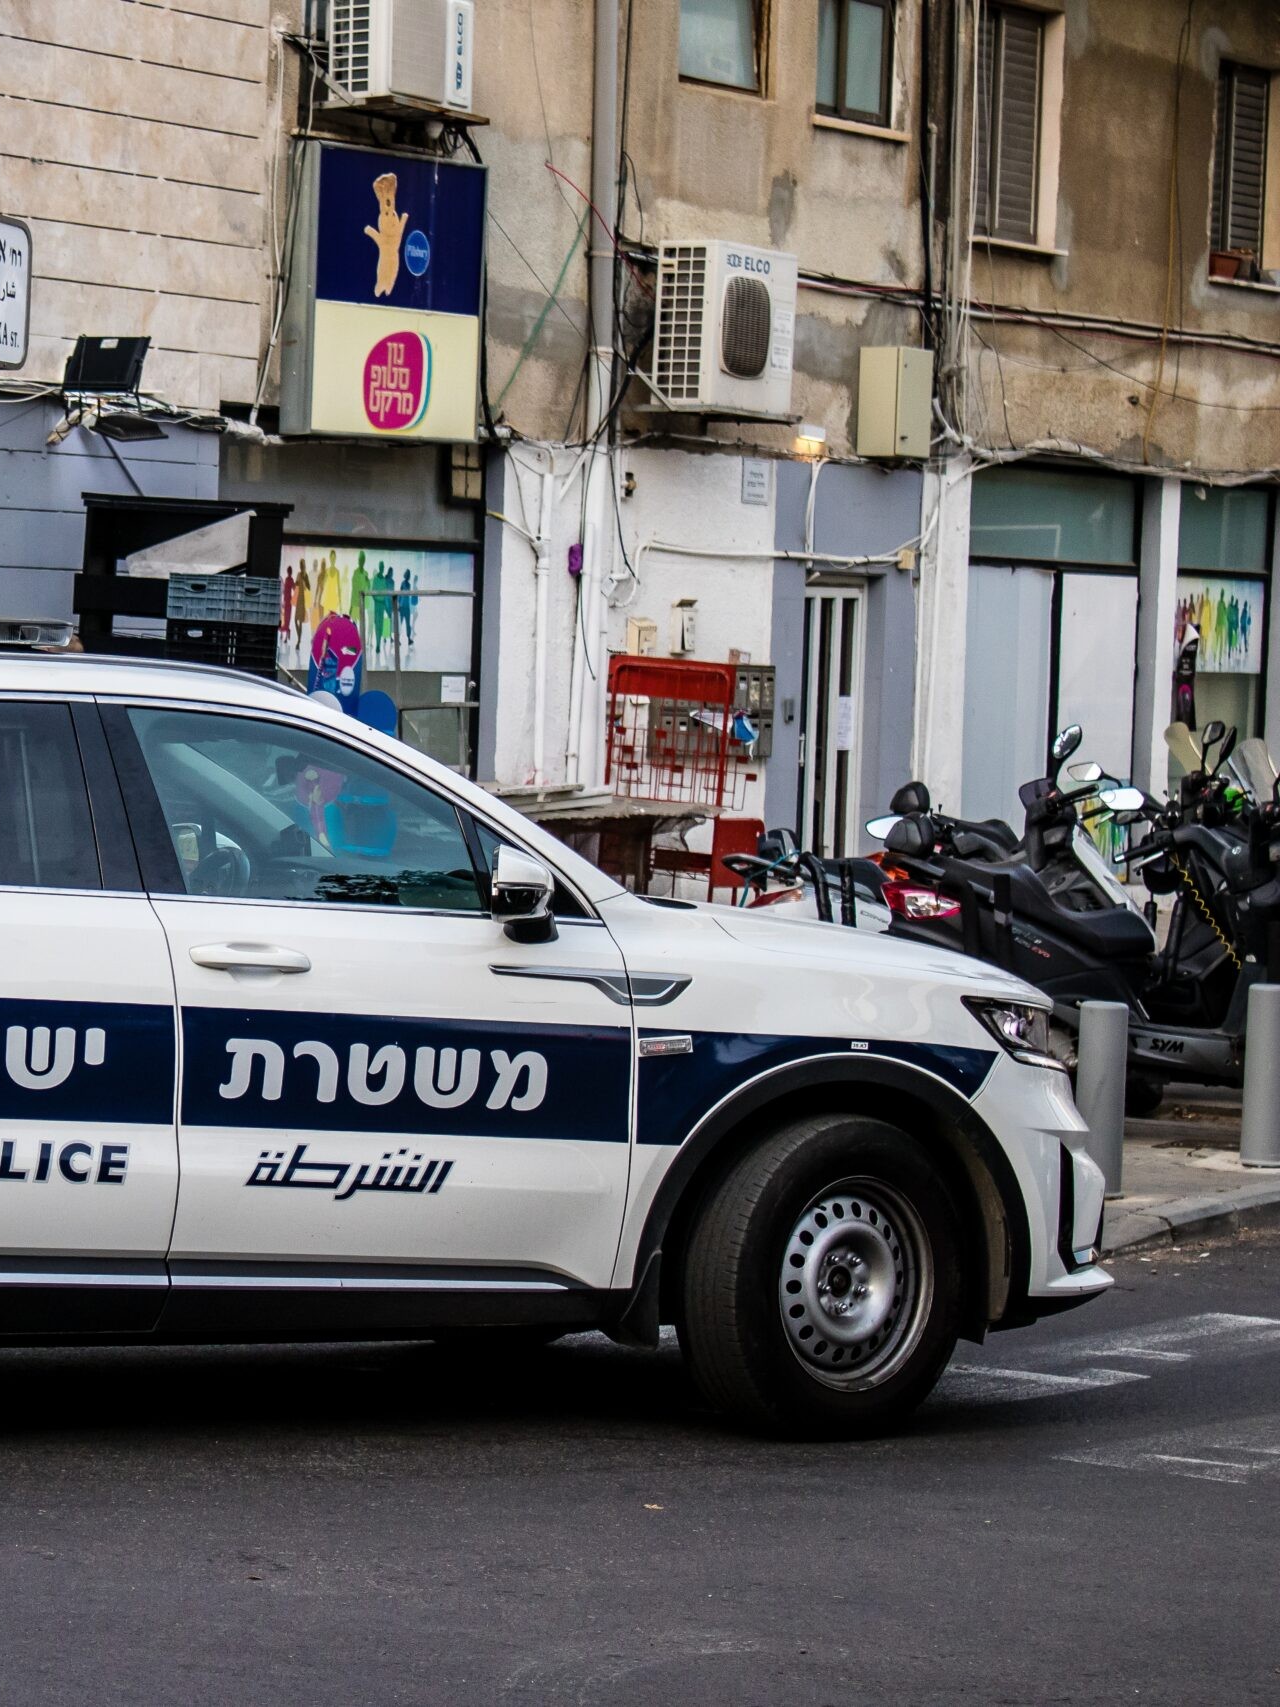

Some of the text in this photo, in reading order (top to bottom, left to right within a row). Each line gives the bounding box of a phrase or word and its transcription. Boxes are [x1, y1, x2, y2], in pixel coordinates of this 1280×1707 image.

[743, 256, 771, 275] ELCO
[10, 331, 20, 348] ST.
[387, 341, 405, 365] נון
[370, 364, 410, 389] סטופ
[370, 389, 414, 422] מרקט
[1149, 1038, 1185, 1054] SYM
[218, 1037, 549, 1111] משטרת
[243, 1142, 457, 1201] الشرطة
